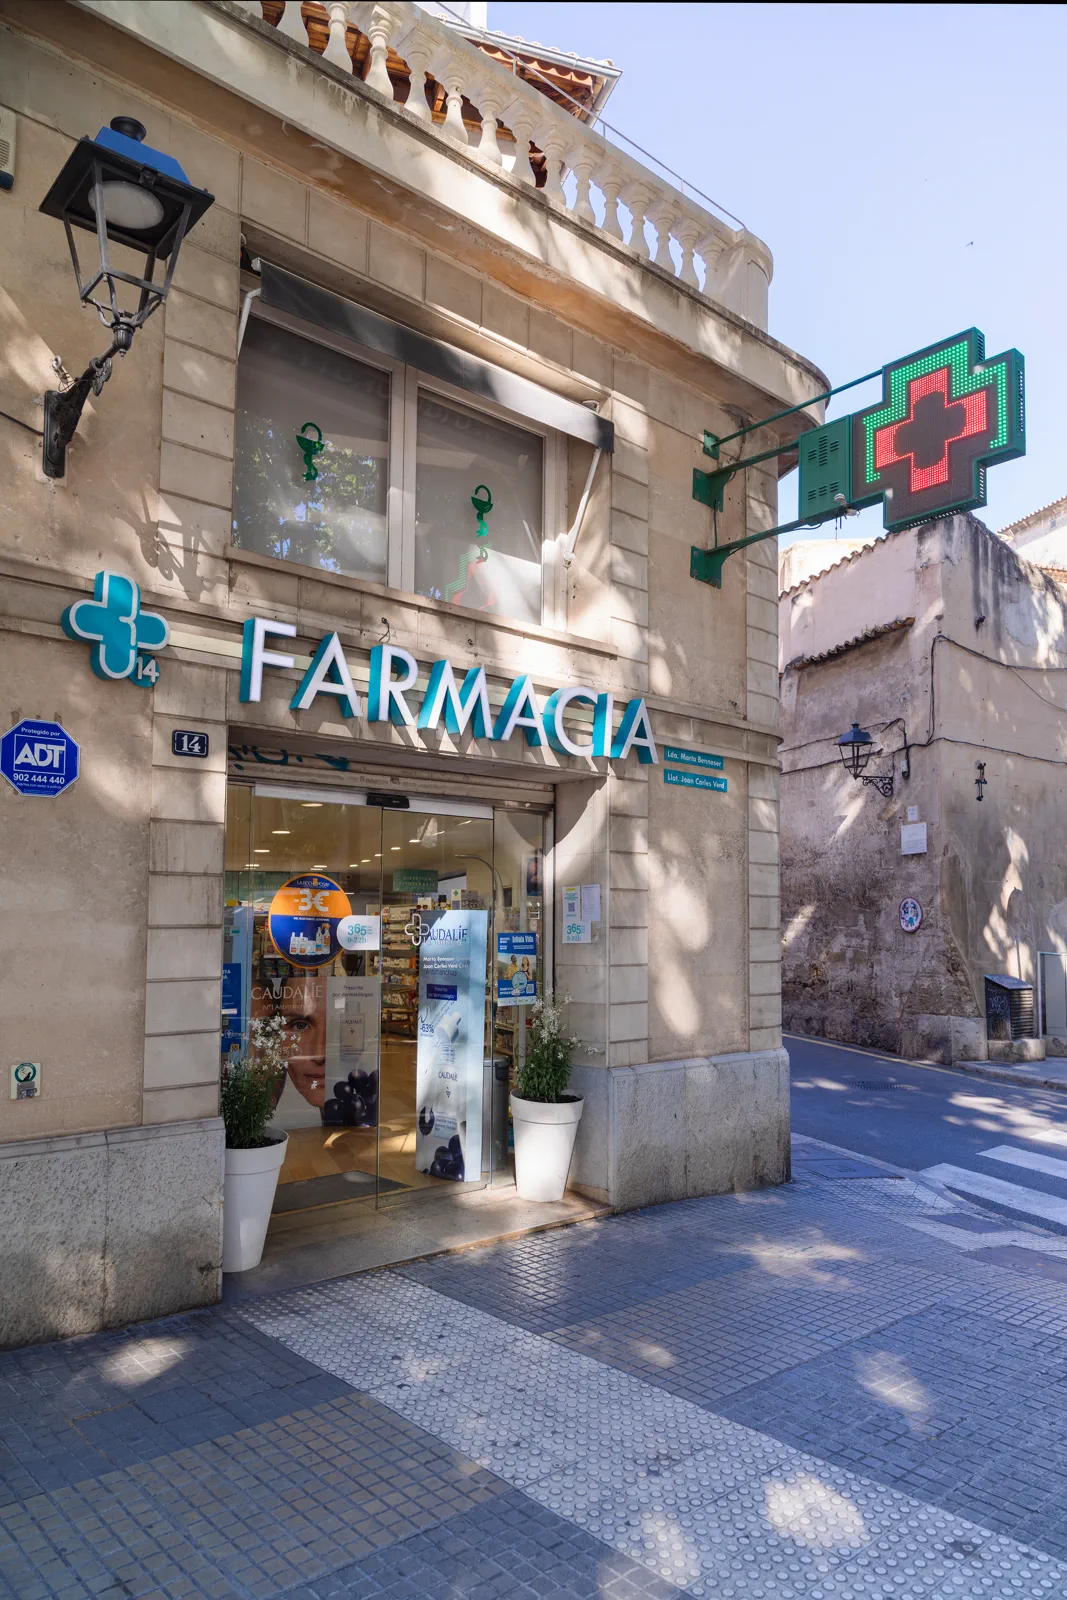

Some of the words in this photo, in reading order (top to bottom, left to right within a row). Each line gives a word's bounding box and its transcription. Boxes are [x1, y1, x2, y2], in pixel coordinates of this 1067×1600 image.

[136, 656, 160, 683] 14
[239, 617, 660, 765] FARMACIA
[21, 727, 50, 736] Protegido
[181, 734, 201, 753] 14
[15, 742, 65, 768] ADT
[13, 773, 30, 782] 902
[31, 775, 47, 783] 444
[49, 776, 65, 785] 440
[681, 776, 695, 784] Joan
[293, 888, 330, 912] -3€
[347, 923, 367, 936] 365
[566, 923, 581, 935] 365
[251, 982, 324, 1000] CAUDALÍE
